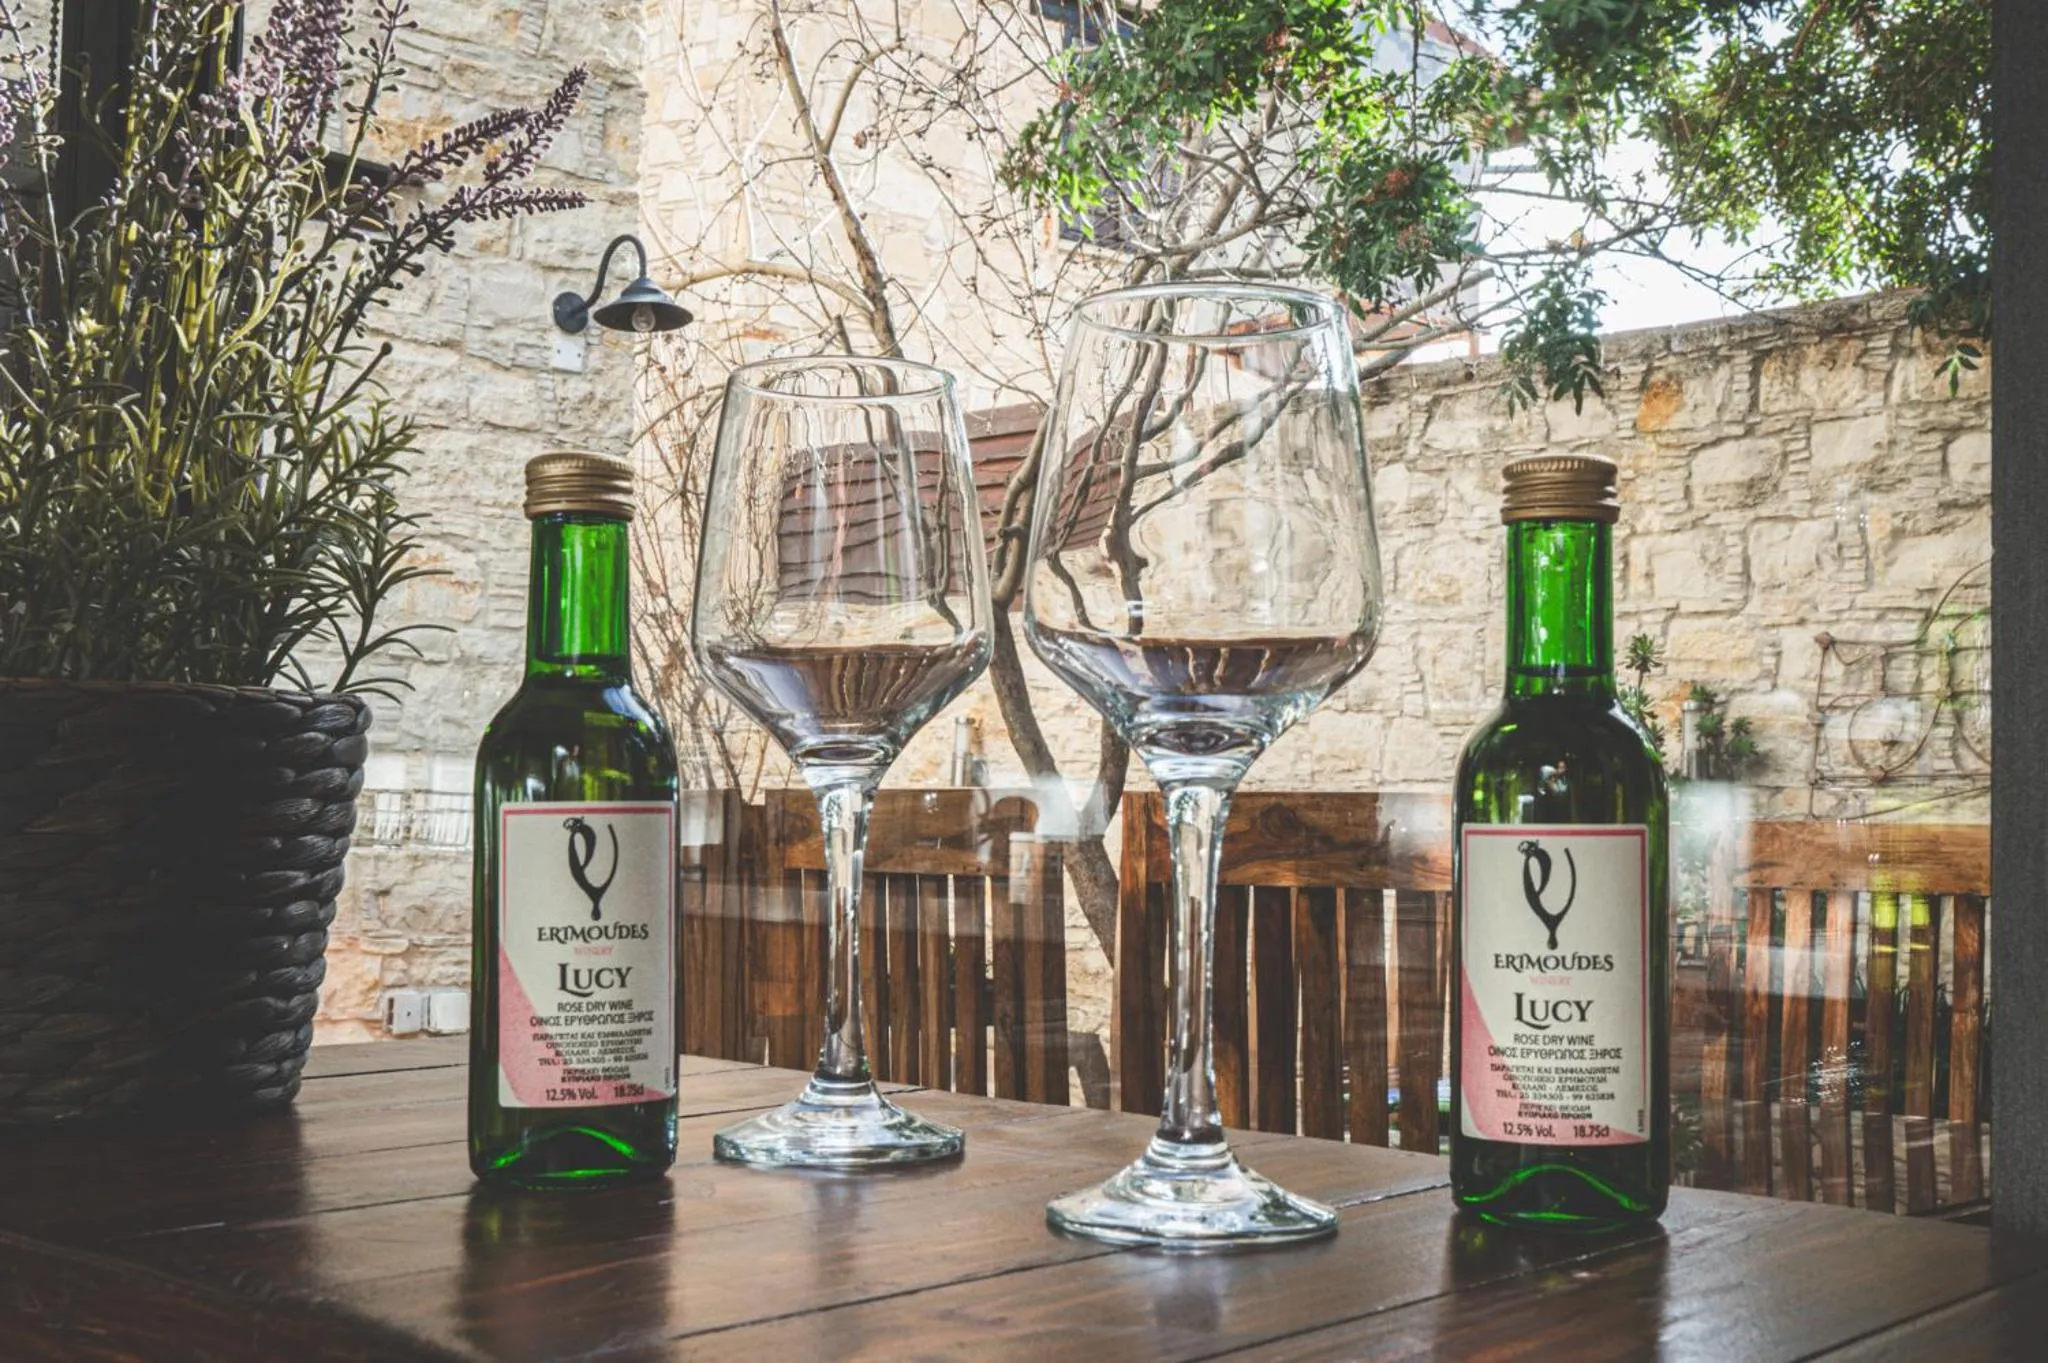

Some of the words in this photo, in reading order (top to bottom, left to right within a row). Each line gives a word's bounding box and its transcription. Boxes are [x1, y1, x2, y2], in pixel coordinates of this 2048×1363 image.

[586, 1000, 606, 1012] DRY
[607, 999, 634, 1010] WINE
[1543, 1035, 1564, 1046] DRY
[1566, 1035, 1595, 1046] WINE
[1503, 1121, 1534, 1137] 12.5%
[1535, 1123, 1556, 1138] Vol.
